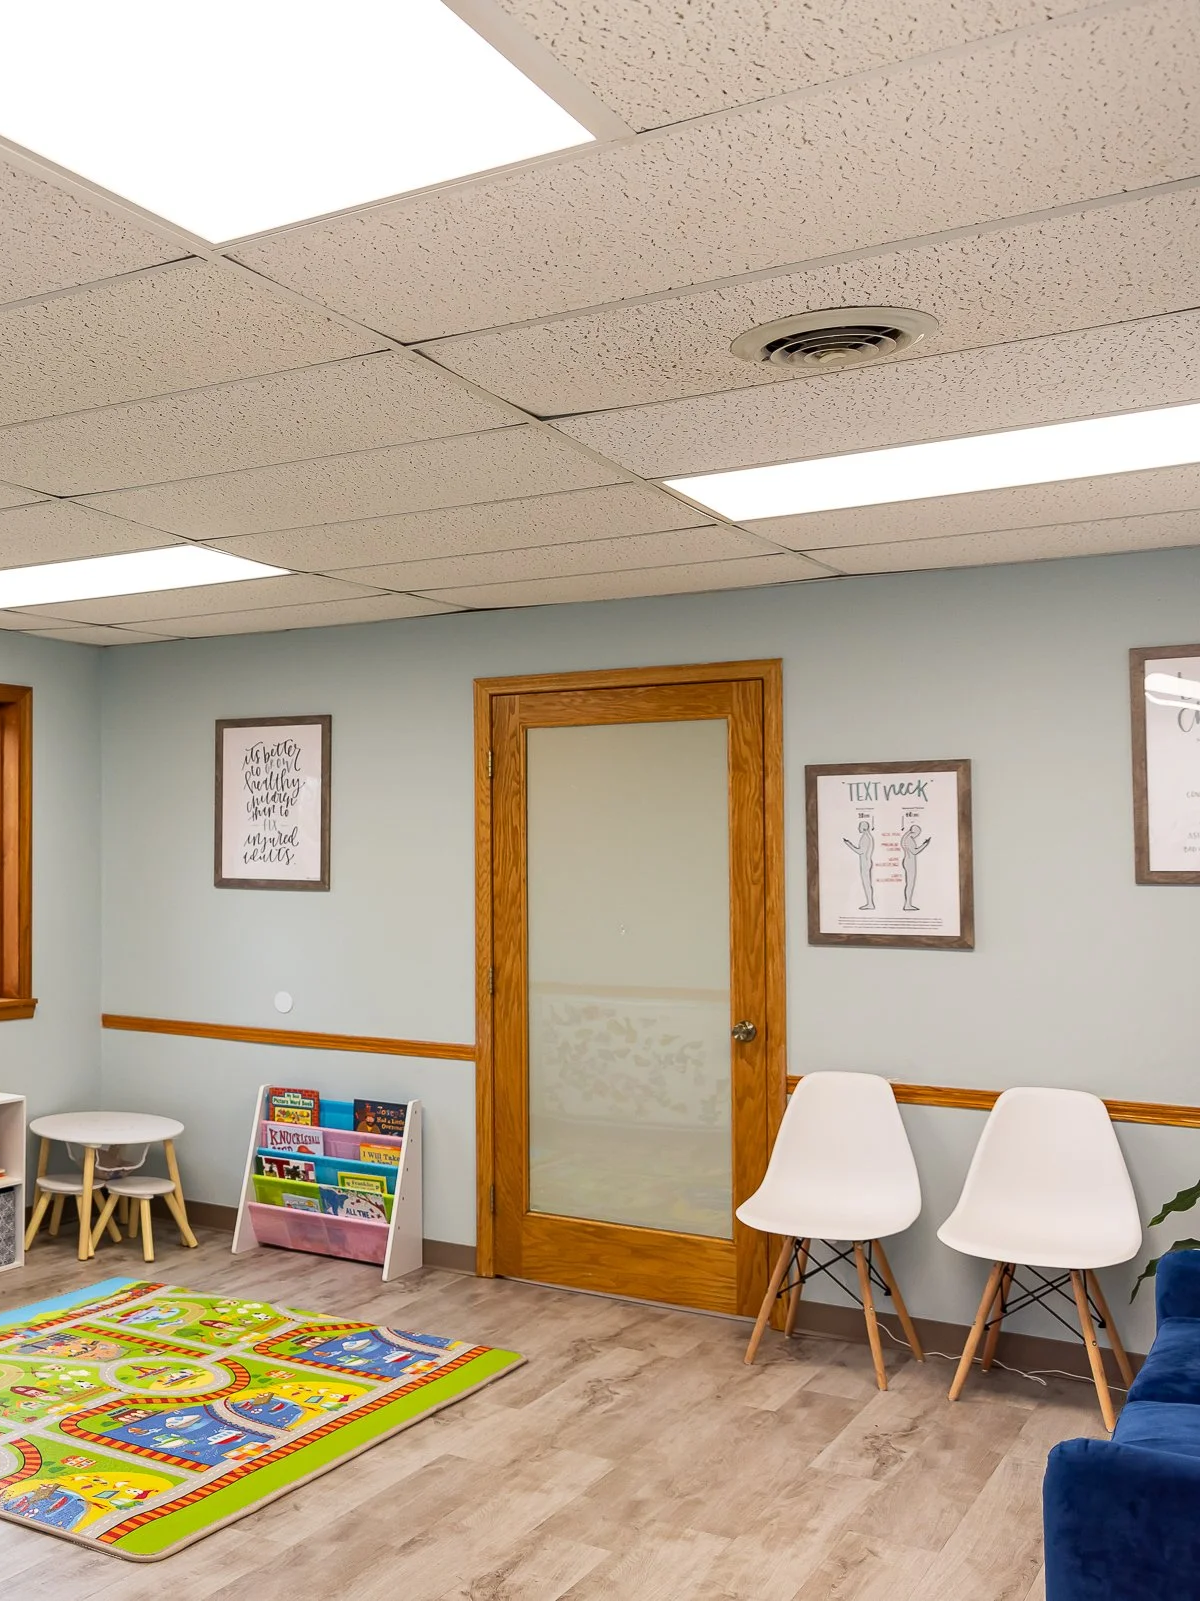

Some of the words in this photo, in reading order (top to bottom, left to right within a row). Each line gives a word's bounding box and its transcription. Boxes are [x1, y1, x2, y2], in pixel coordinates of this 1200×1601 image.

[263, 739, 301, 772] better
[244, 768, 305, 799] healthy
[847, 781, 881, 802] TEXT
[883, 780, 929, 802] neck
[247, 791, 298, 813] children
[248, 804, 275, 821] than
[279, 805, 289, 817] to
[243, 826, 300, 853] injured
[269, 1128, 320, 1145] KNUCKLEBALL
[357, 1210, 371, 1219] THE
